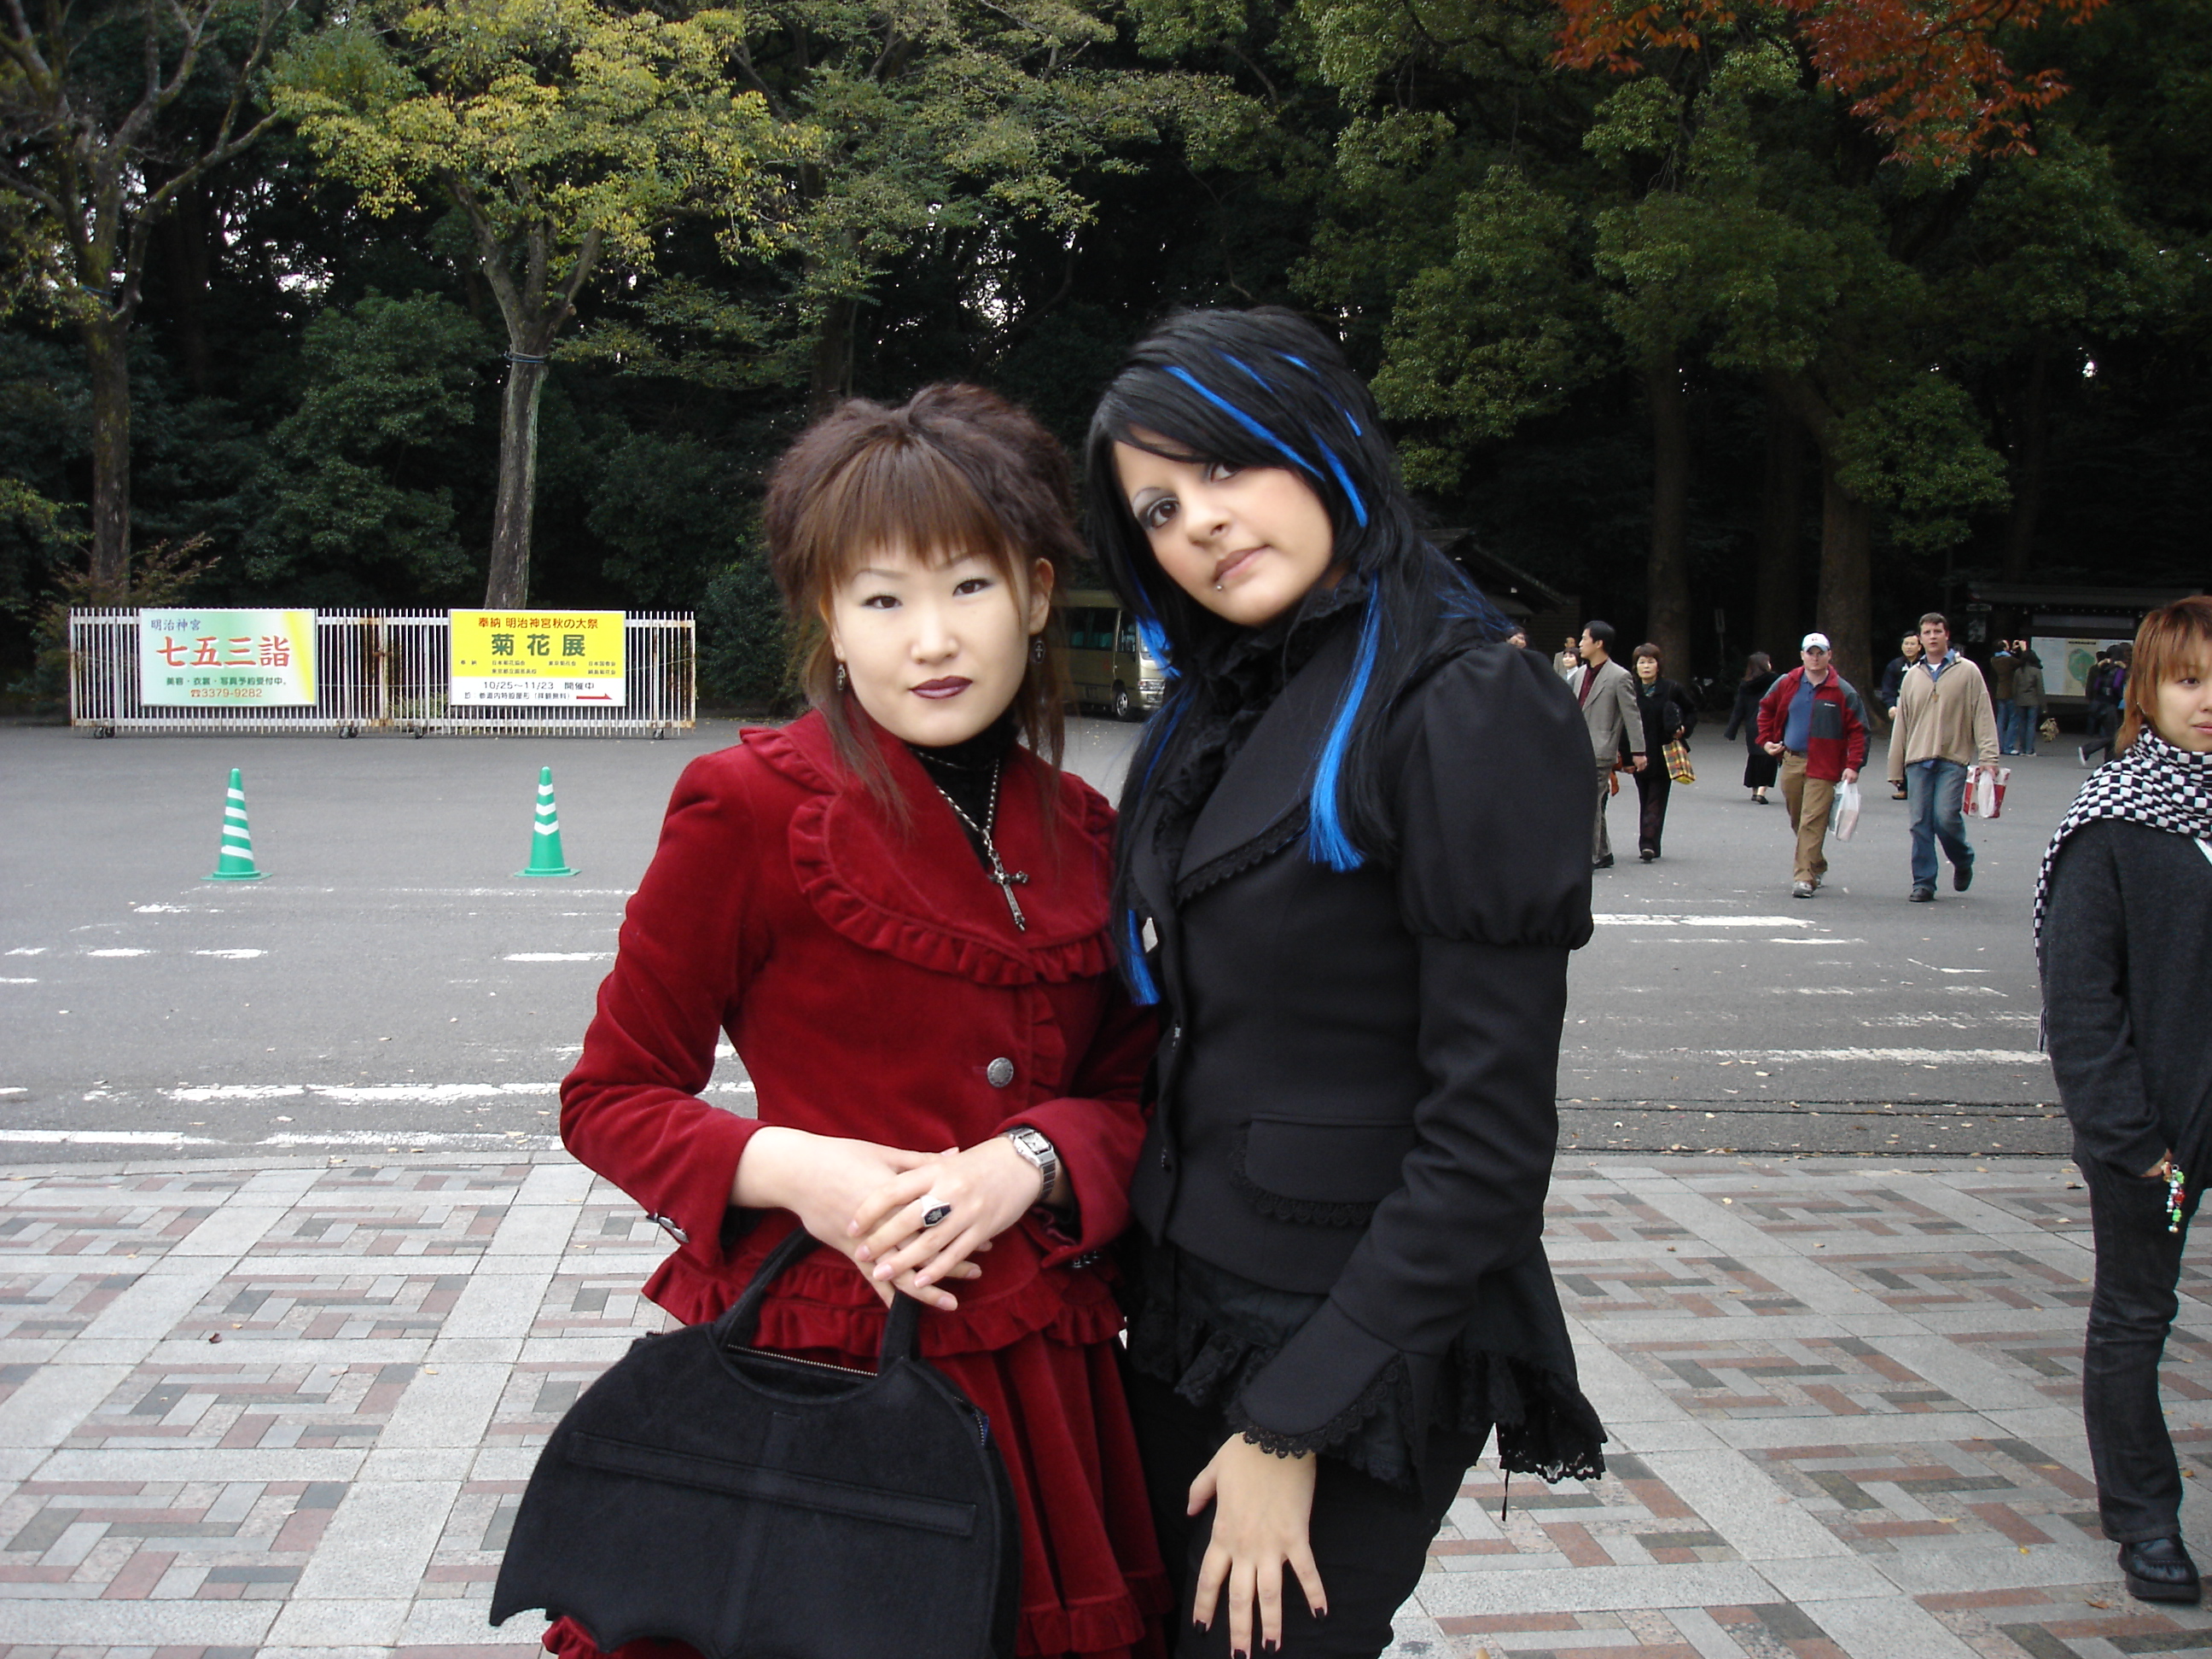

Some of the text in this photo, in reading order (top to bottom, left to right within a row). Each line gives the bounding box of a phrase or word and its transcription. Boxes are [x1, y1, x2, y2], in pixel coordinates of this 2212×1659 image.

[151, 619, 201, 632] 明治神宮
[479, 617, 598, 629] 奉納 明治神宮秋の大祭
[492, 633, 585, 656] 菊花展
[155, 636, 290, 667] 七五三詣
[564, 682, 595, 690] 開催中
